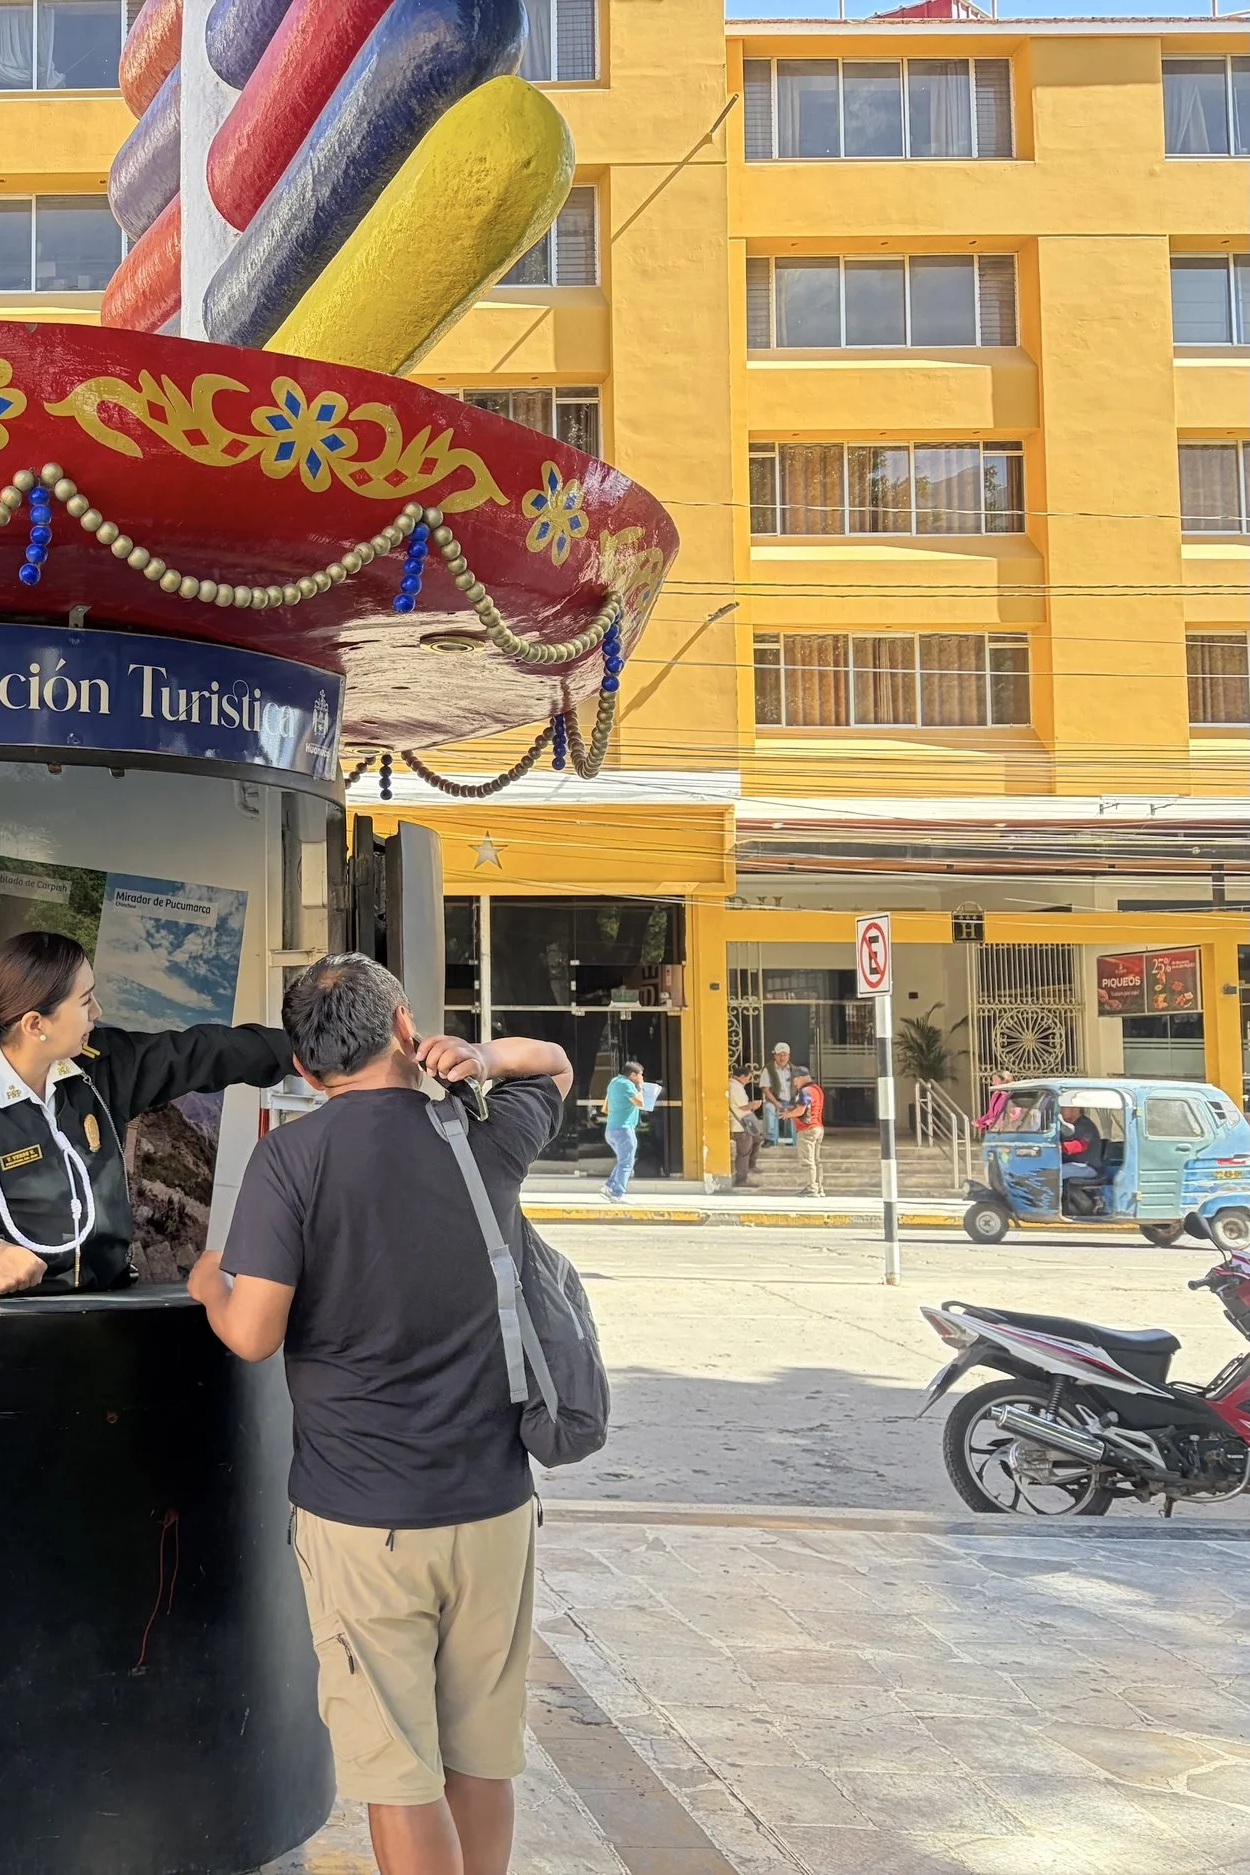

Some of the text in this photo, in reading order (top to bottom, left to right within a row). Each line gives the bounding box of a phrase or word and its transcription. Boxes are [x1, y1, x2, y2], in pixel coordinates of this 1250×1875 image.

[127, 663, 294, 738] Turistica
[24, 879, 36, 888] de
[37, 880, 68, 893] Carpish
[116, 891, 211, 914] Mirador de Pucumarca
[961, 923, 976, 939] H
[868, 935, 882, 975] E
[1151, 957, 1172, 974] 25%
[1102, 976, 1141, 988] PIQUEOS
